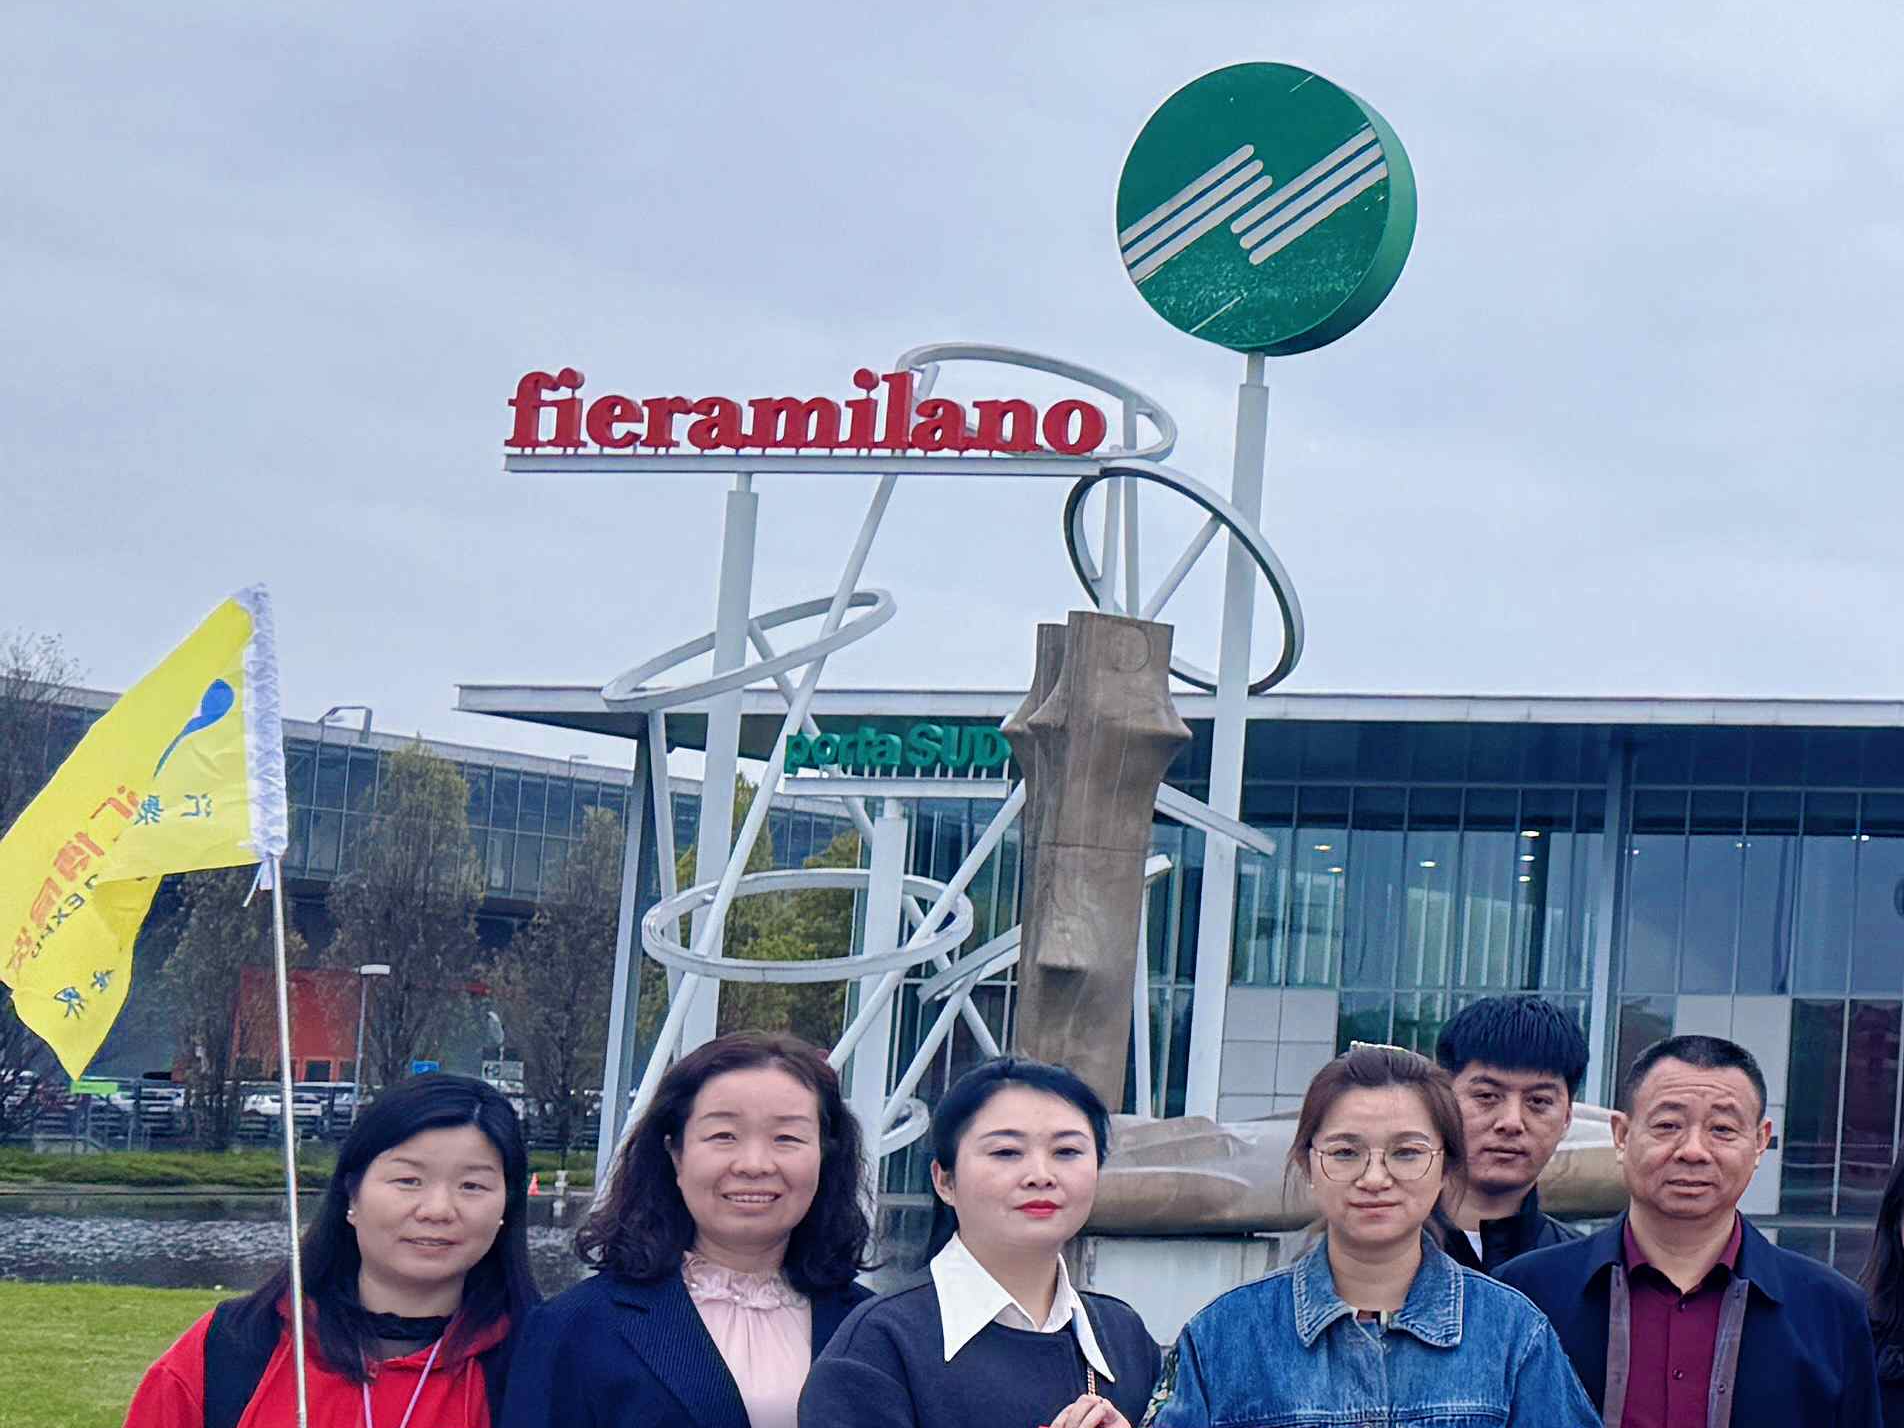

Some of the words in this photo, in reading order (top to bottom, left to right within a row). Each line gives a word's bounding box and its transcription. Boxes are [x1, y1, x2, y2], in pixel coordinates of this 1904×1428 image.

[504, 367, 1107, 454] fieramilano
[784, 727, 901, 774] porta
[905, 722, 1011, 767] SUD
